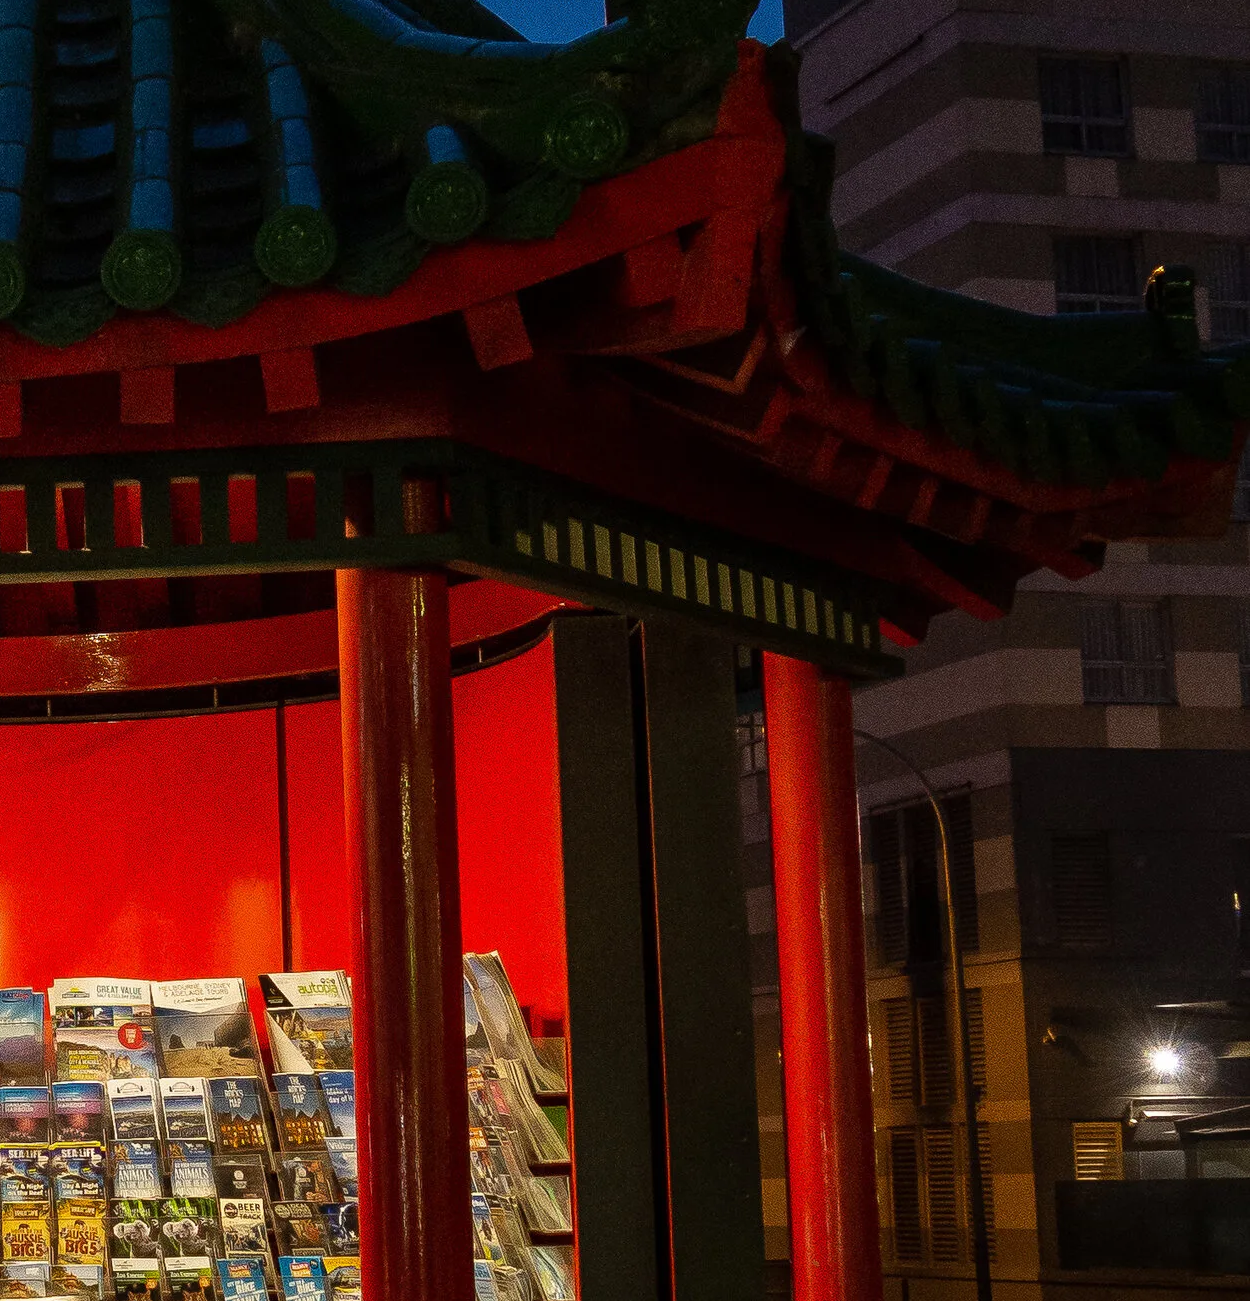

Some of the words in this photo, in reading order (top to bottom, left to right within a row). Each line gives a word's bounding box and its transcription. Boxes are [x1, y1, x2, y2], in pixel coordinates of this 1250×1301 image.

[96, 985, 119, 994] GREAT
[120, 986, 142, 995] VALUE
[158, 982, 201, 991] MELBOURNE
[204, 982, 231, 990] SYDNEY
[298, 982, 339, 996] autopia
[207, 988, 230, 996] TOURS
[229, 1098, 242, 1108] MAP
[292, 1094, 305, 1104] MAP
[328, 1096, 340, 1105] day
[9, 1150, 24, 1159] SEA
[62, 1149, 77, 1158] SEA
[118, 1170, 155, 1182] ANIMALS
[174, 1168, 210, 1181] ANIMALS
[7, 1183, 20, 1191] Day
[62, 1182, 75, 1190] Day
[82, 1182, 99, 1190] Night
[12, 1233, 44, 1243] AUSSIE
[67, 1230, 99, 1241] AUSSIE
[11, 1243, 35, 1257] BIG
[35, 1244, 45, 1257] 5
[66, 1240, 89, 1255] BIG
[90, 1242, 98, 1256] 5
[236, 1282, 256, 1293] BIKE
[296, 1281, 316, 1293] BIKE
